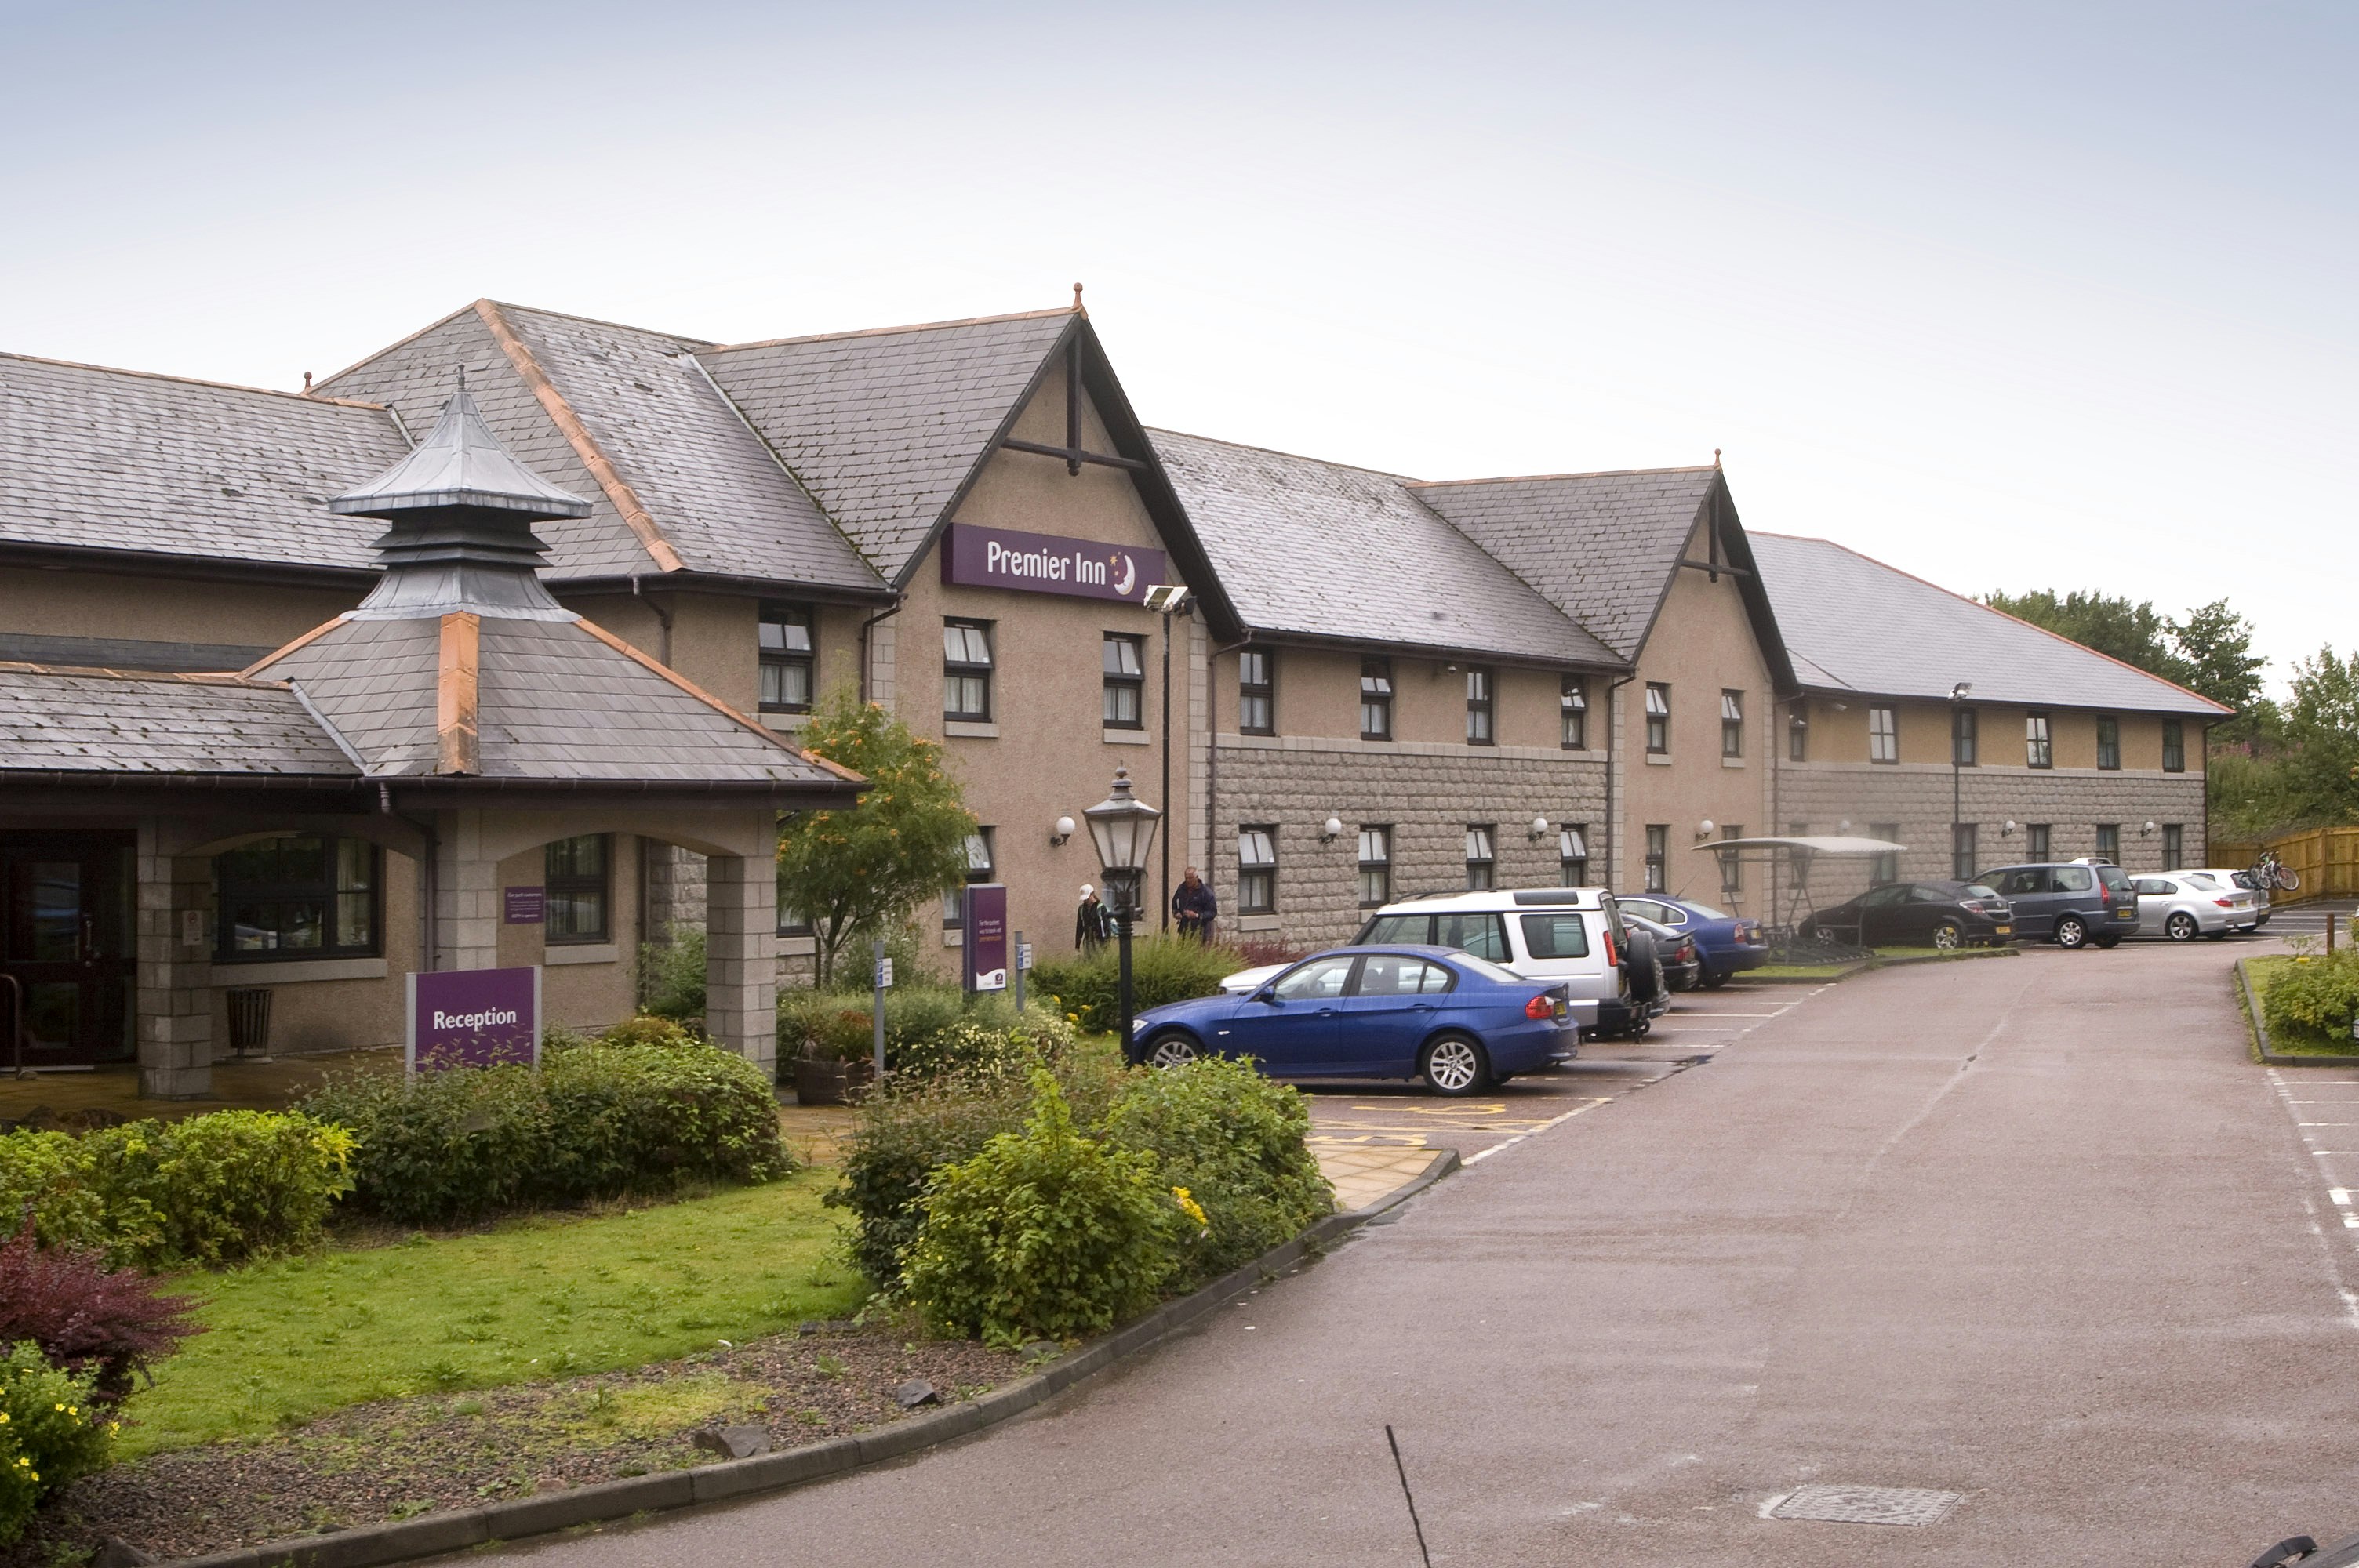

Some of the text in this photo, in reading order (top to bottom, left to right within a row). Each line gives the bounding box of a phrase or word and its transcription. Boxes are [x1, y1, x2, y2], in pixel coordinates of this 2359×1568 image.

[987, 540, 1106, 586] Premier Inn
[434, 1007, 517, 1033] Reception
